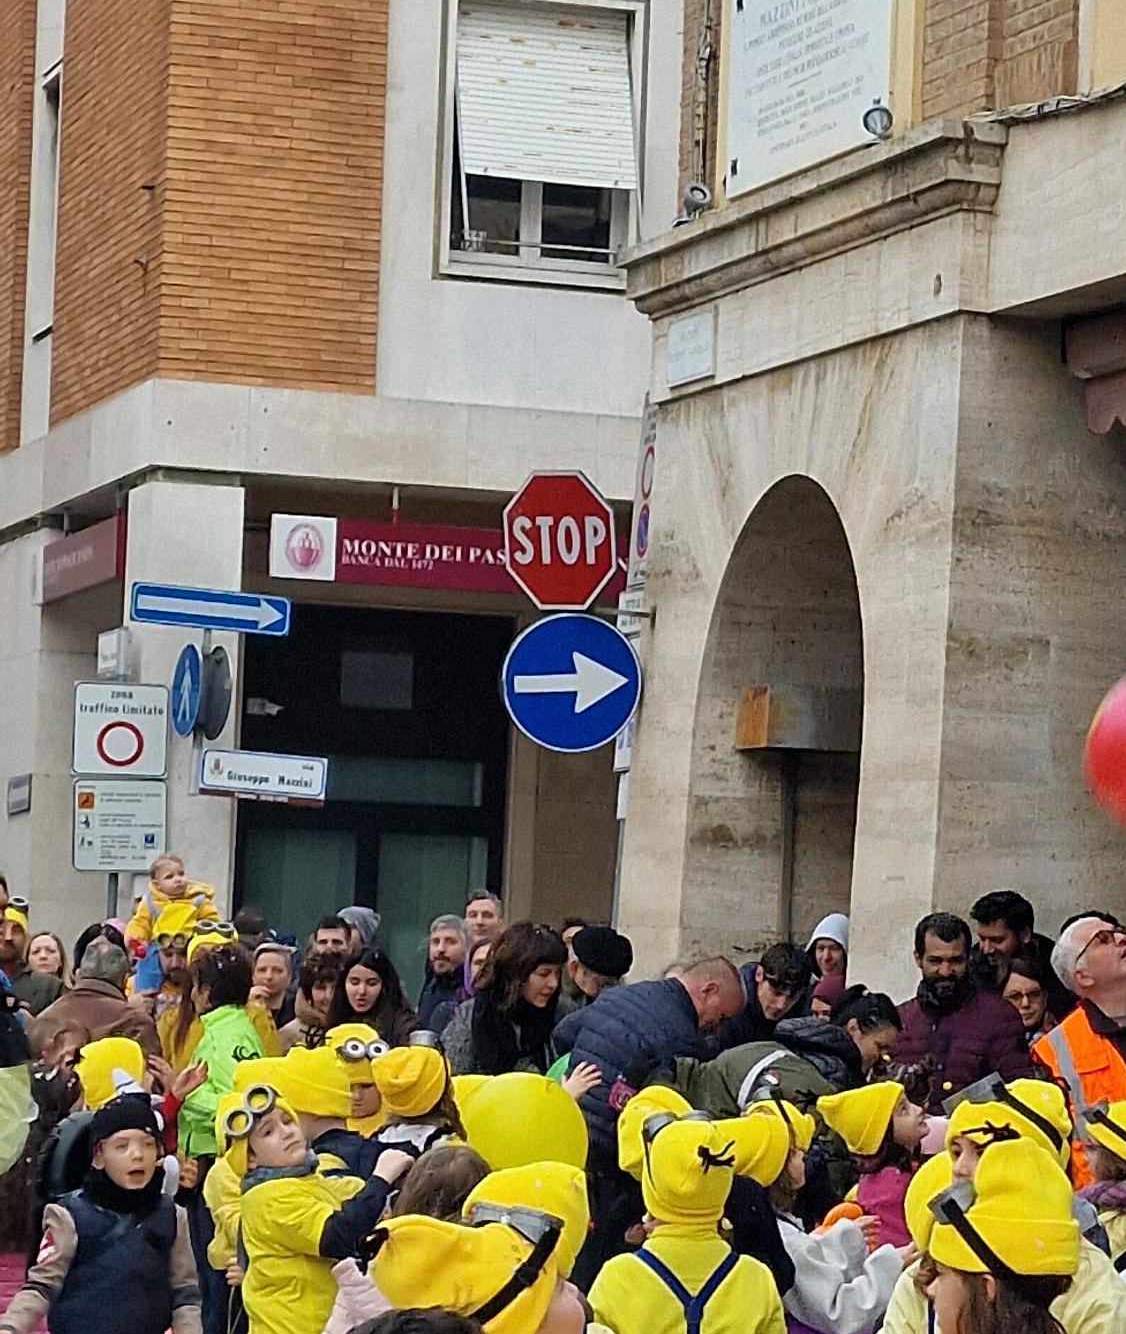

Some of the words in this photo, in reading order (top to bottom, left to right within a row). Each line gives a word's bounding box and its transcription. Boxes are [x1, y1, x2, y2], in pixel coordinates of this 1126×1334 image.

[342, 538, 420, 560] MONTE
[424, 543, 462, 562] DEI
[468, 547, 506, 566] PAS
[512, 515, 607, 566] STOP
[80, 703, 119, 713] traffico
[122, 704, 164, 715] limitato
[227, 770, 270, 785] Giuseppe
[278, 774, 313, 788] Mazzini
